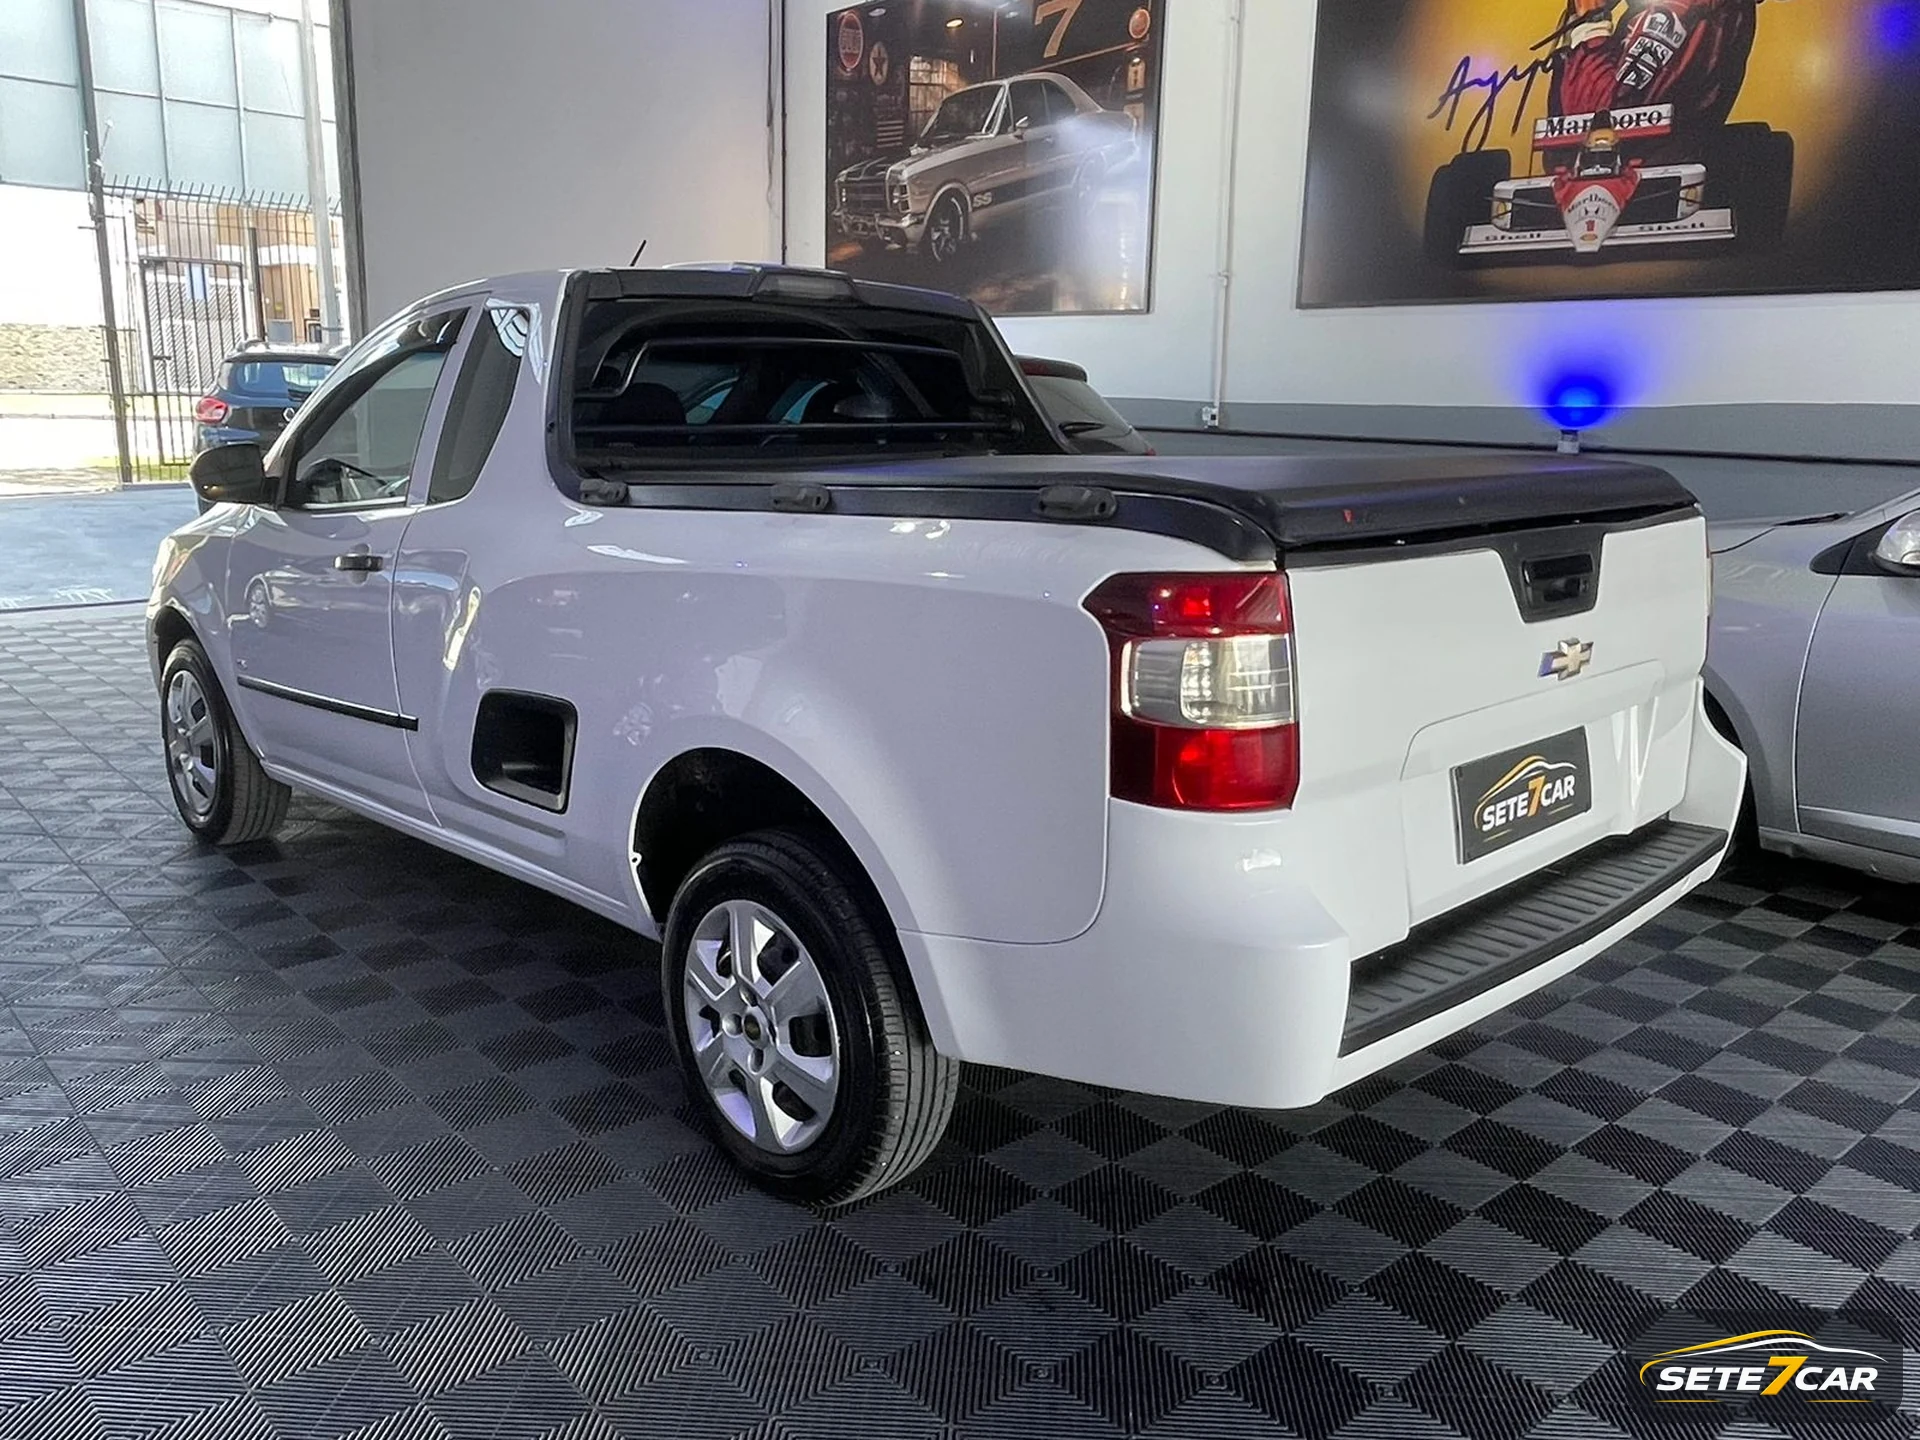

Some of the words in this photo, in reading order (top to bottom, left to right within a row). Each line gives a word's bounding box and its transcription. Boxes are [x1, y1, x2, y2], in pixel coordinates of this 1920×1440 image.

[1035, 0, 1084, 58] 7
[1633, 37, 1670, 62] BOSS
[1545, 109, 1662, 137] Maroro
[973, 192, 992, 208] SS
[1585, 220, 1595, 232] 1
[1639, 221, 1705, 231] Shell
[1485, 232, 1541, 241] Shell
[1481, 775, 1575, 832] SETE7CAR
